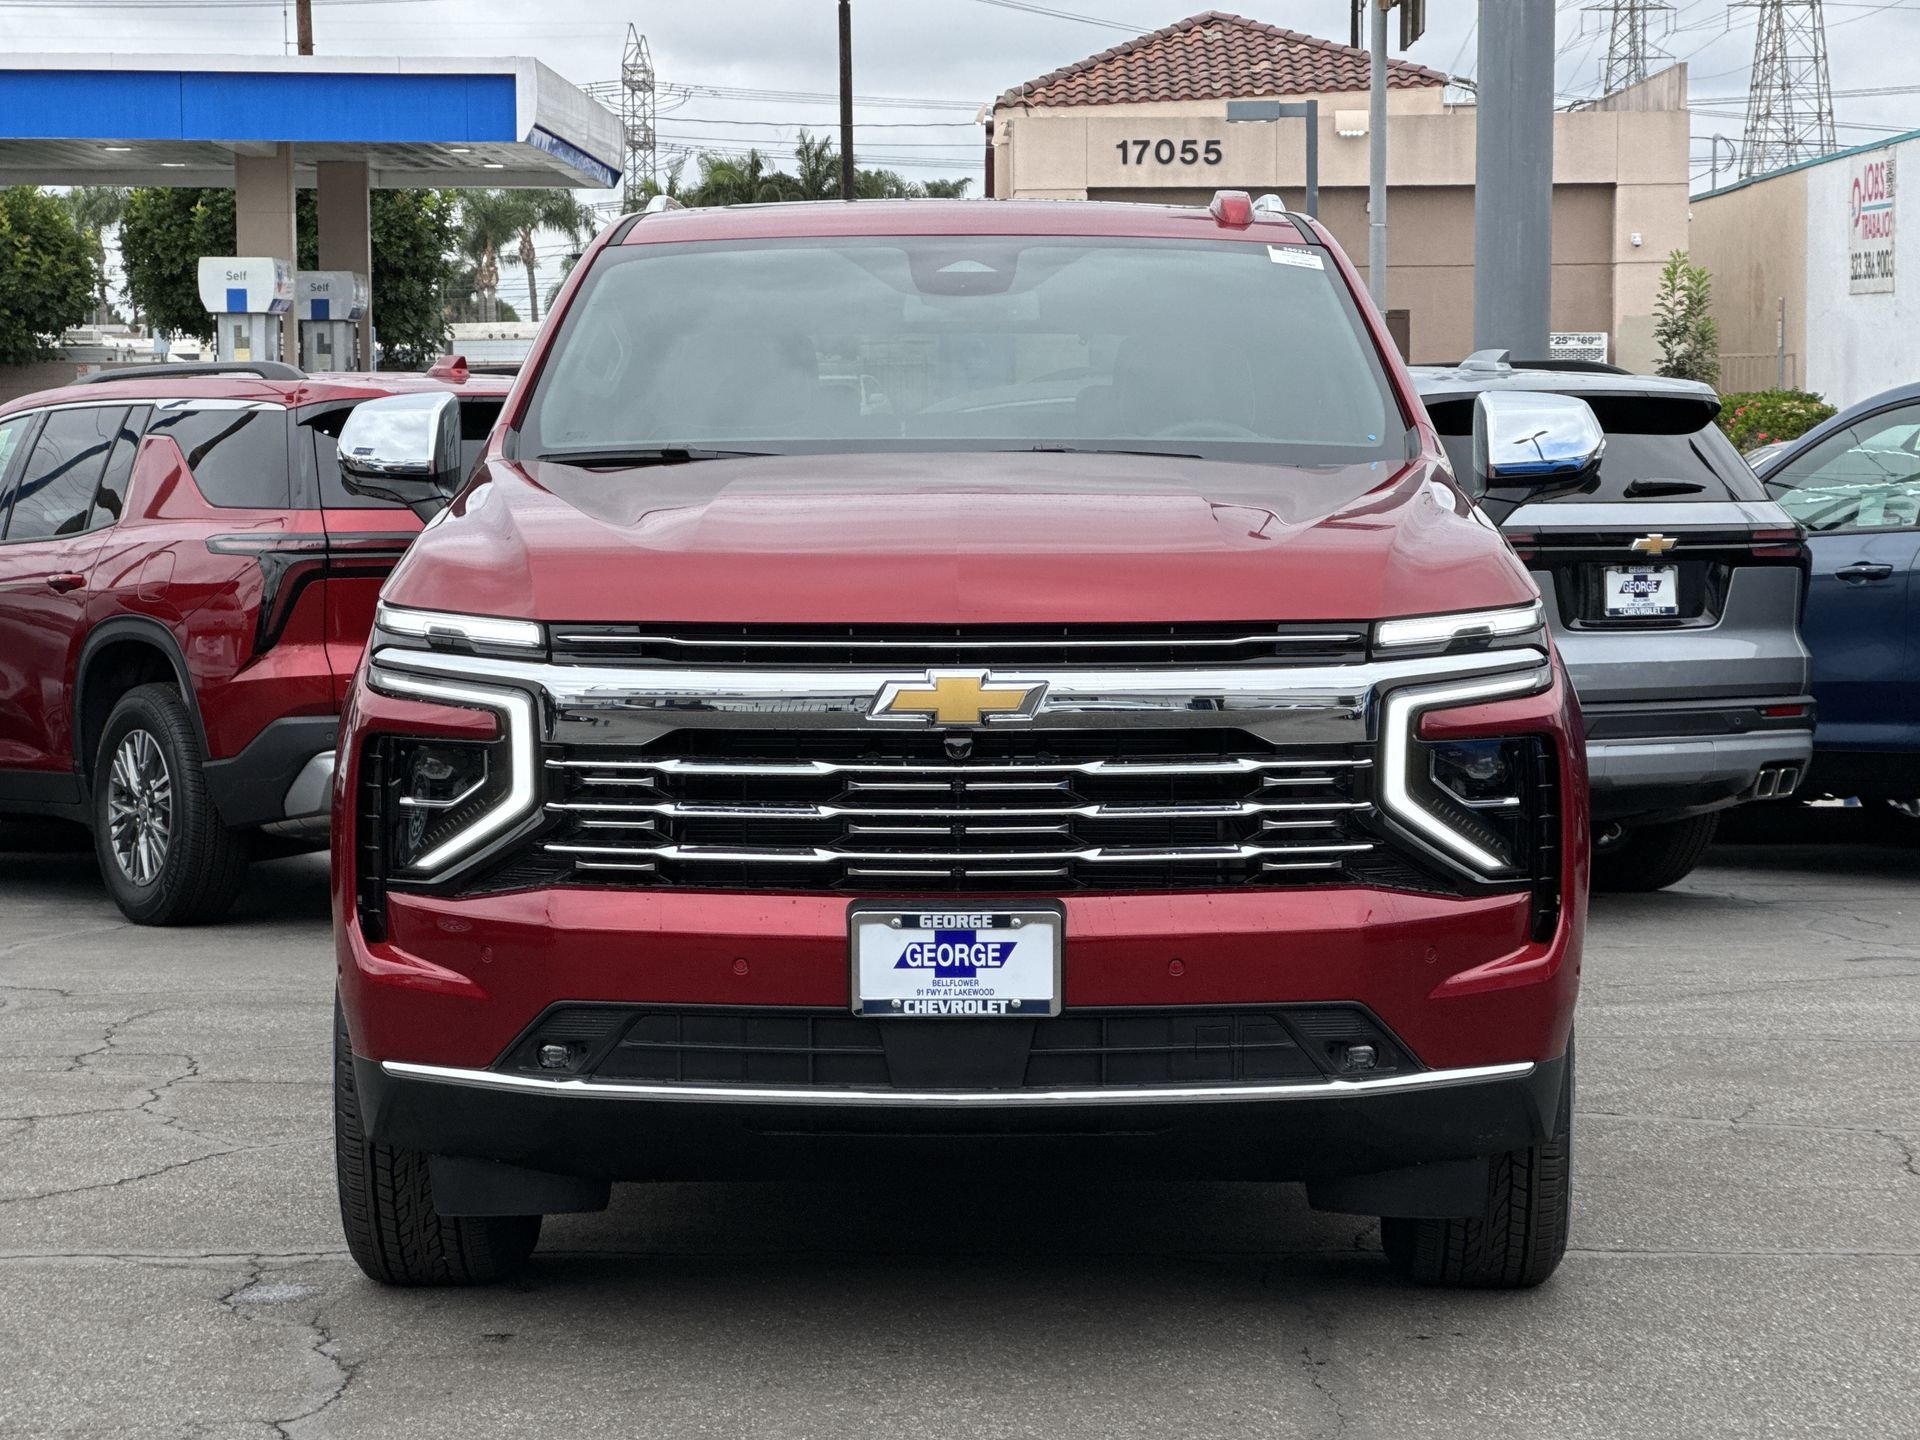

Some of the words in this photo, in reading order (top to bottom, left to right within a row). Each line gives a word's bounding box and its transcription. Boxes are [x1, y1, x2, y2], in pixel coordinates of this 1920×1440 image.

[1116, 138, 1222, 165] 17055
[1862, 161, 1885, 202] JOBS
[226, 271, 248, 281] Self
[310, 283, 329, 292] Self
[1623, 581, 1658, 593] GEORGE
[1623, 607, 1661, 615] CHEVROLET
[919, 914, 993, 929] GEORGE
[905, 943, 1001, 967] GEORGE
[932, 979, 979, 987] BELLFLOWER
[916, 988, 925, 996] 91
[926, 988, 942, 996] FWY
[943, 988, 953, 996] AT
[953, 988, 995, 996] LAKEWOOD
[903, 1000, 1009, 1014] CHEVROLET
